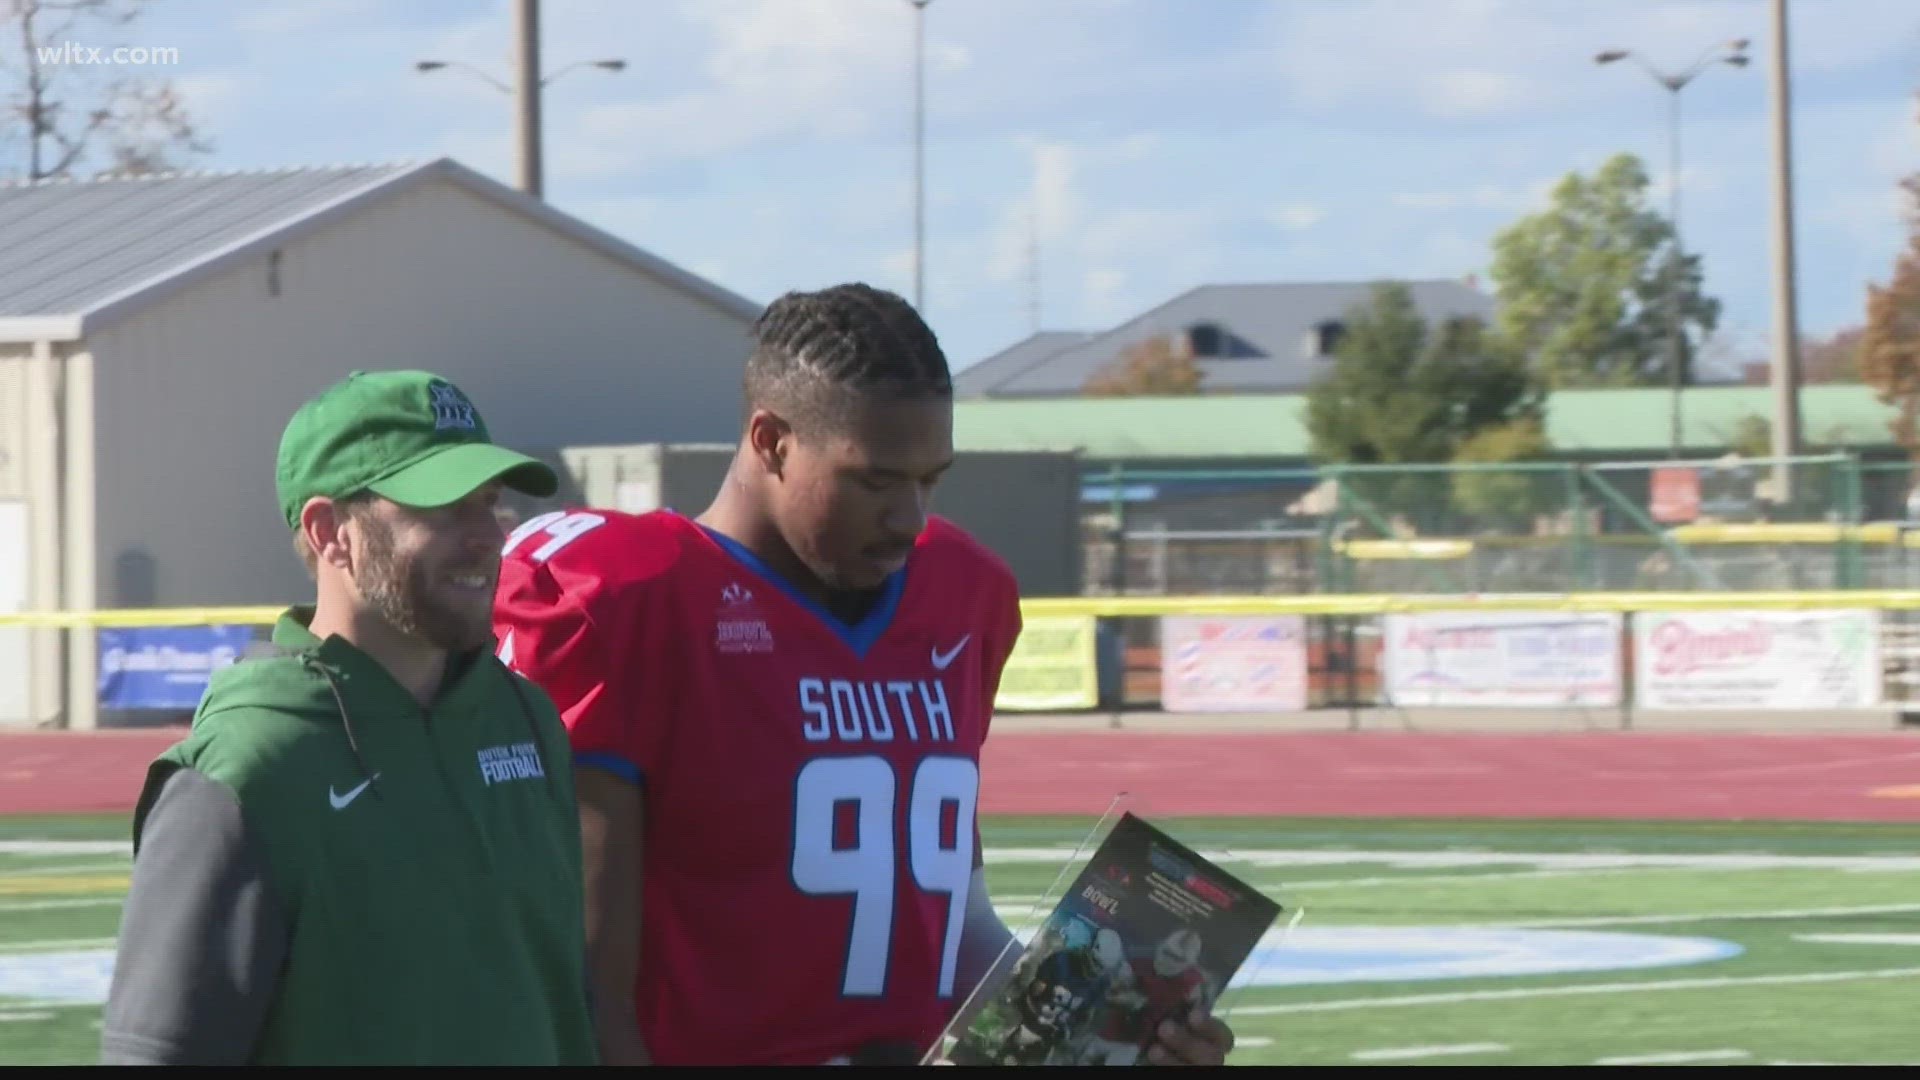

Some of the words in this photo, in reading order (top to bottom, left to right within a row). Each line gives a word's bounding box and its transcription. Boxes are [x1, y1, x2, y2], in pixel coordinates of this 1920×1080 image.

[501, 511, 606, 562] 99
[799, 678, 955, 742] SOUTH
[480, 753, 545, 787] FOOTBALL
[791, 755, 980, 997] 99
[1080, 884, 1120, 917] BOWL
